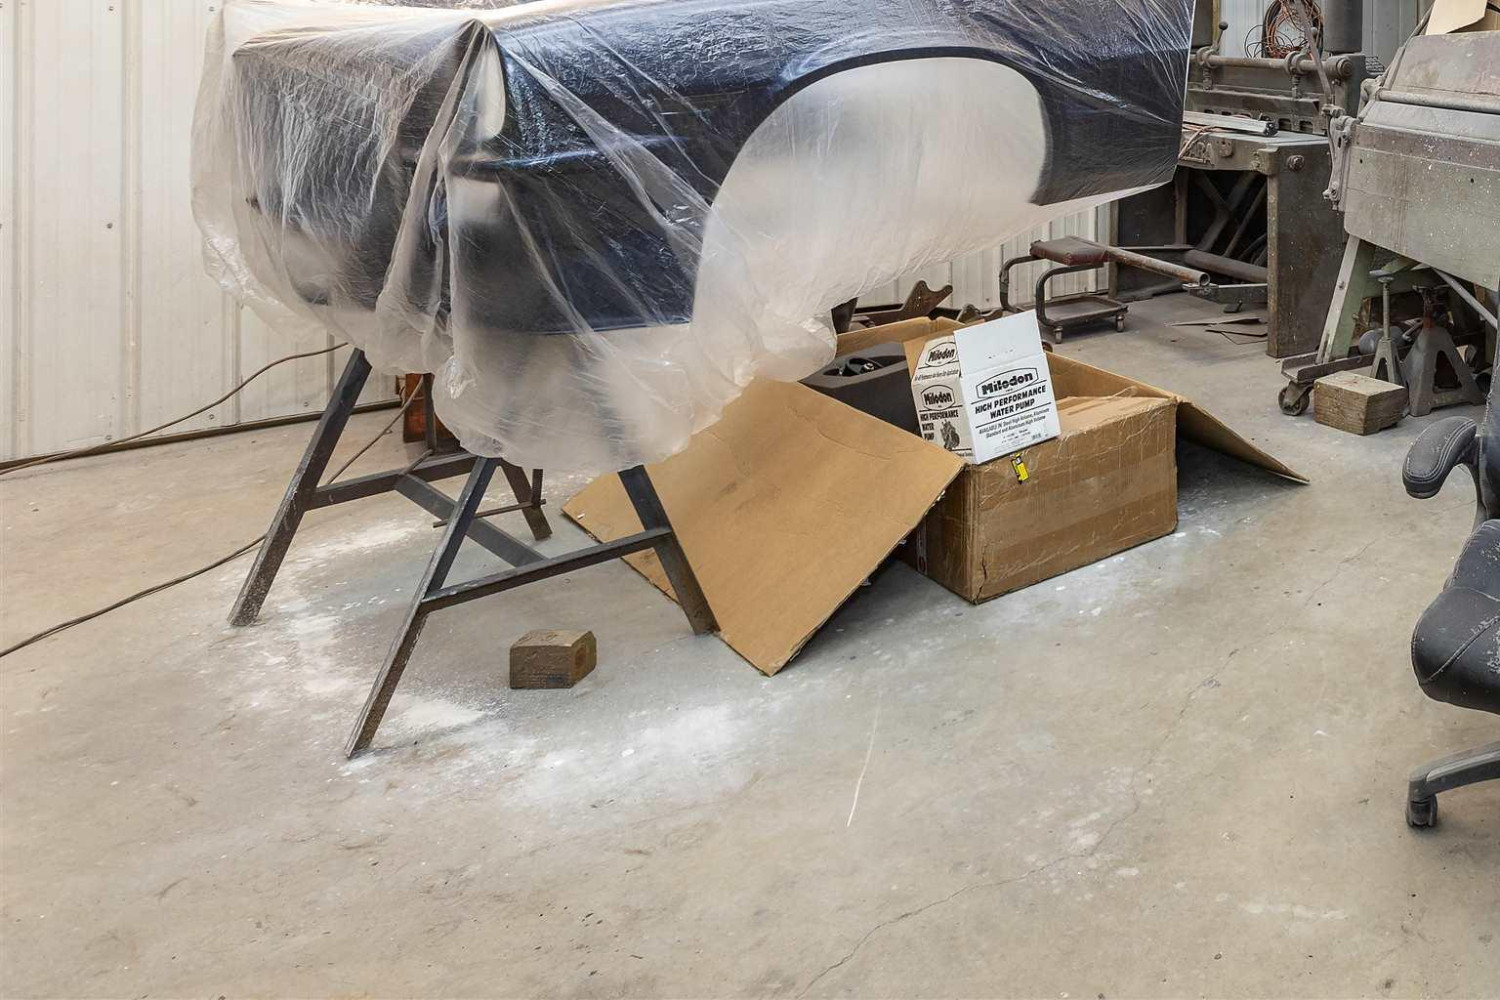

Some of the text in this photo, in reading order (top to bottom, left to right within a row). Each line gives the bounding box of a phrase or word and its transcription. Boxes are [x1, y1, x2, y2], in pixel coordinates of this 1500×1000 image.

[928, 347, 955, 362] Milodon
[981, 373, 1033, 395] Milodon
[923, 391, 952, 405] Milodon
[975, 385, 1046, 414] HIGH PERFORMANCE
[920, 409, 959, 421] HIGH PERFORMANCE
[990, 398, 1035, 419] WATER PUMP
[922, 423, 934, 431] WATER
